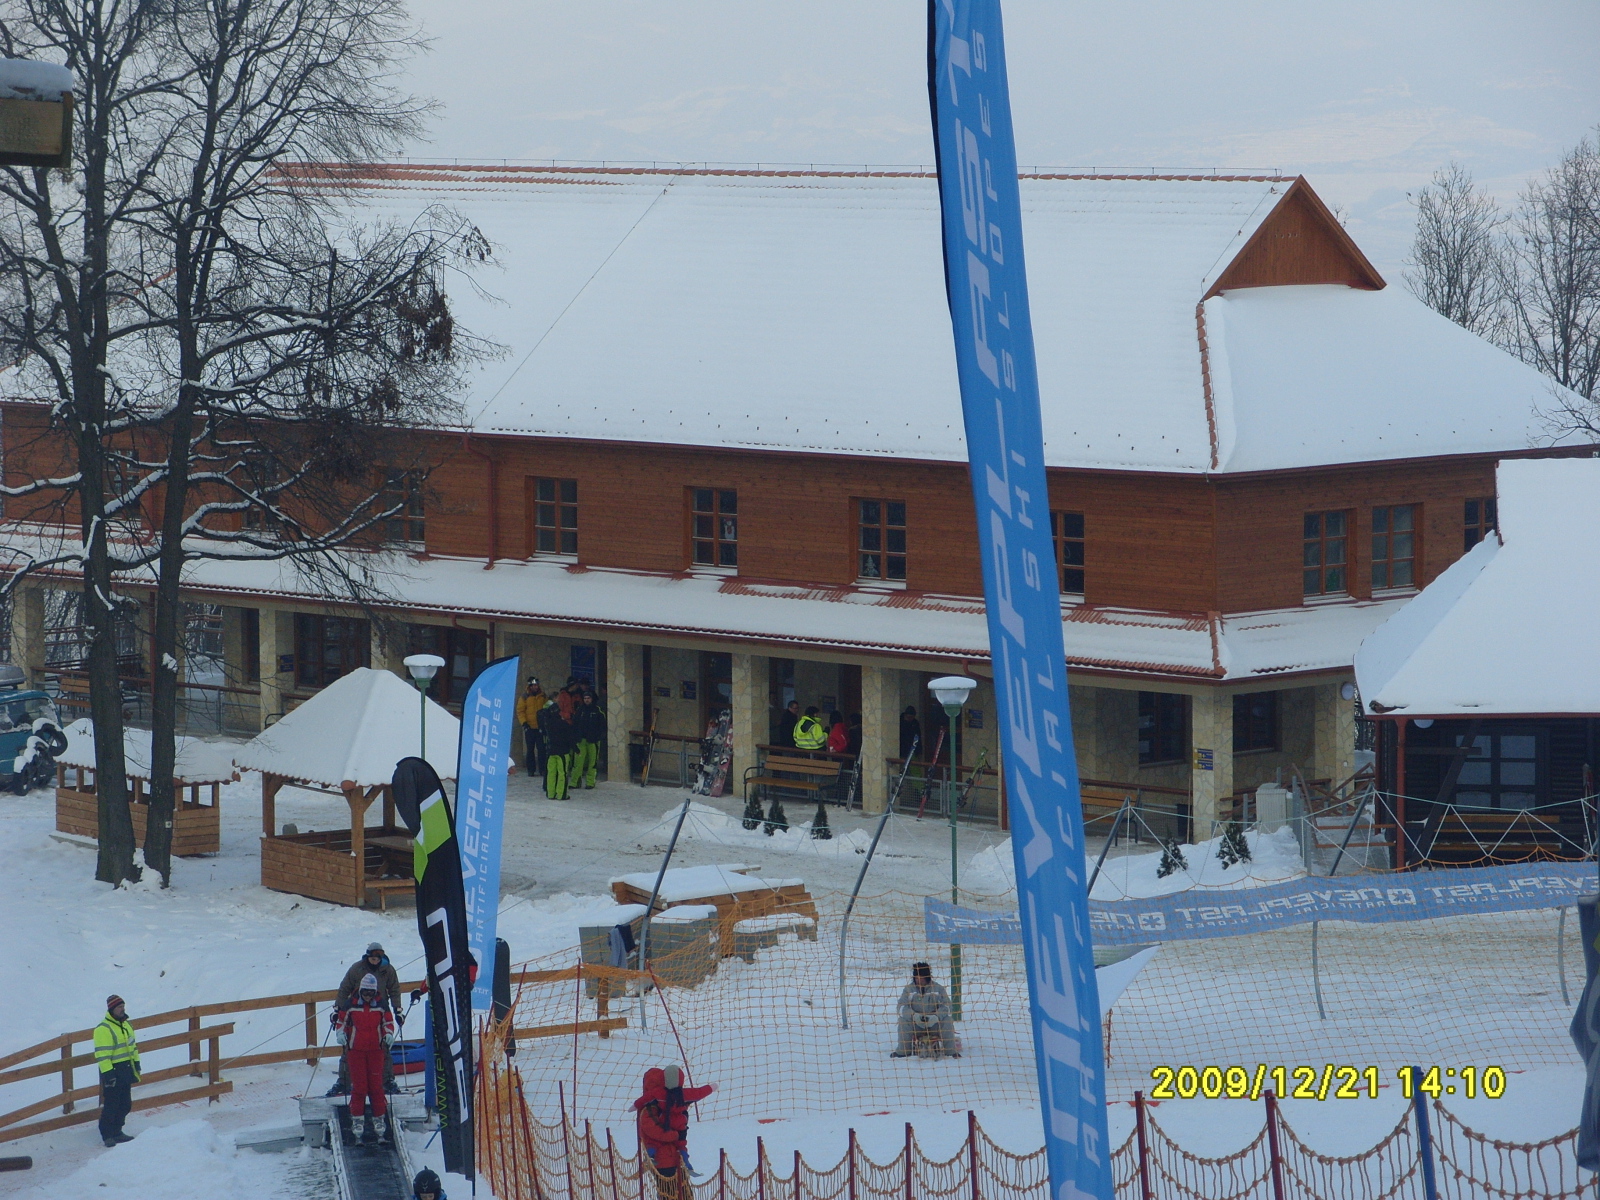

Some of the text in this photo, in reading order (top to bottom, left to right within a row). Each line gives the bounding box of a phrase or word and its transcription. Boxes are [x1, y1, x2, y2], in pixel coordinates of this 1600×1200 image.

[972, 29, 1017, 393] SLOPES
[475, 830, 491, 943] ARTIFICIAL
[488, 698, 502, 776] SLOPES
